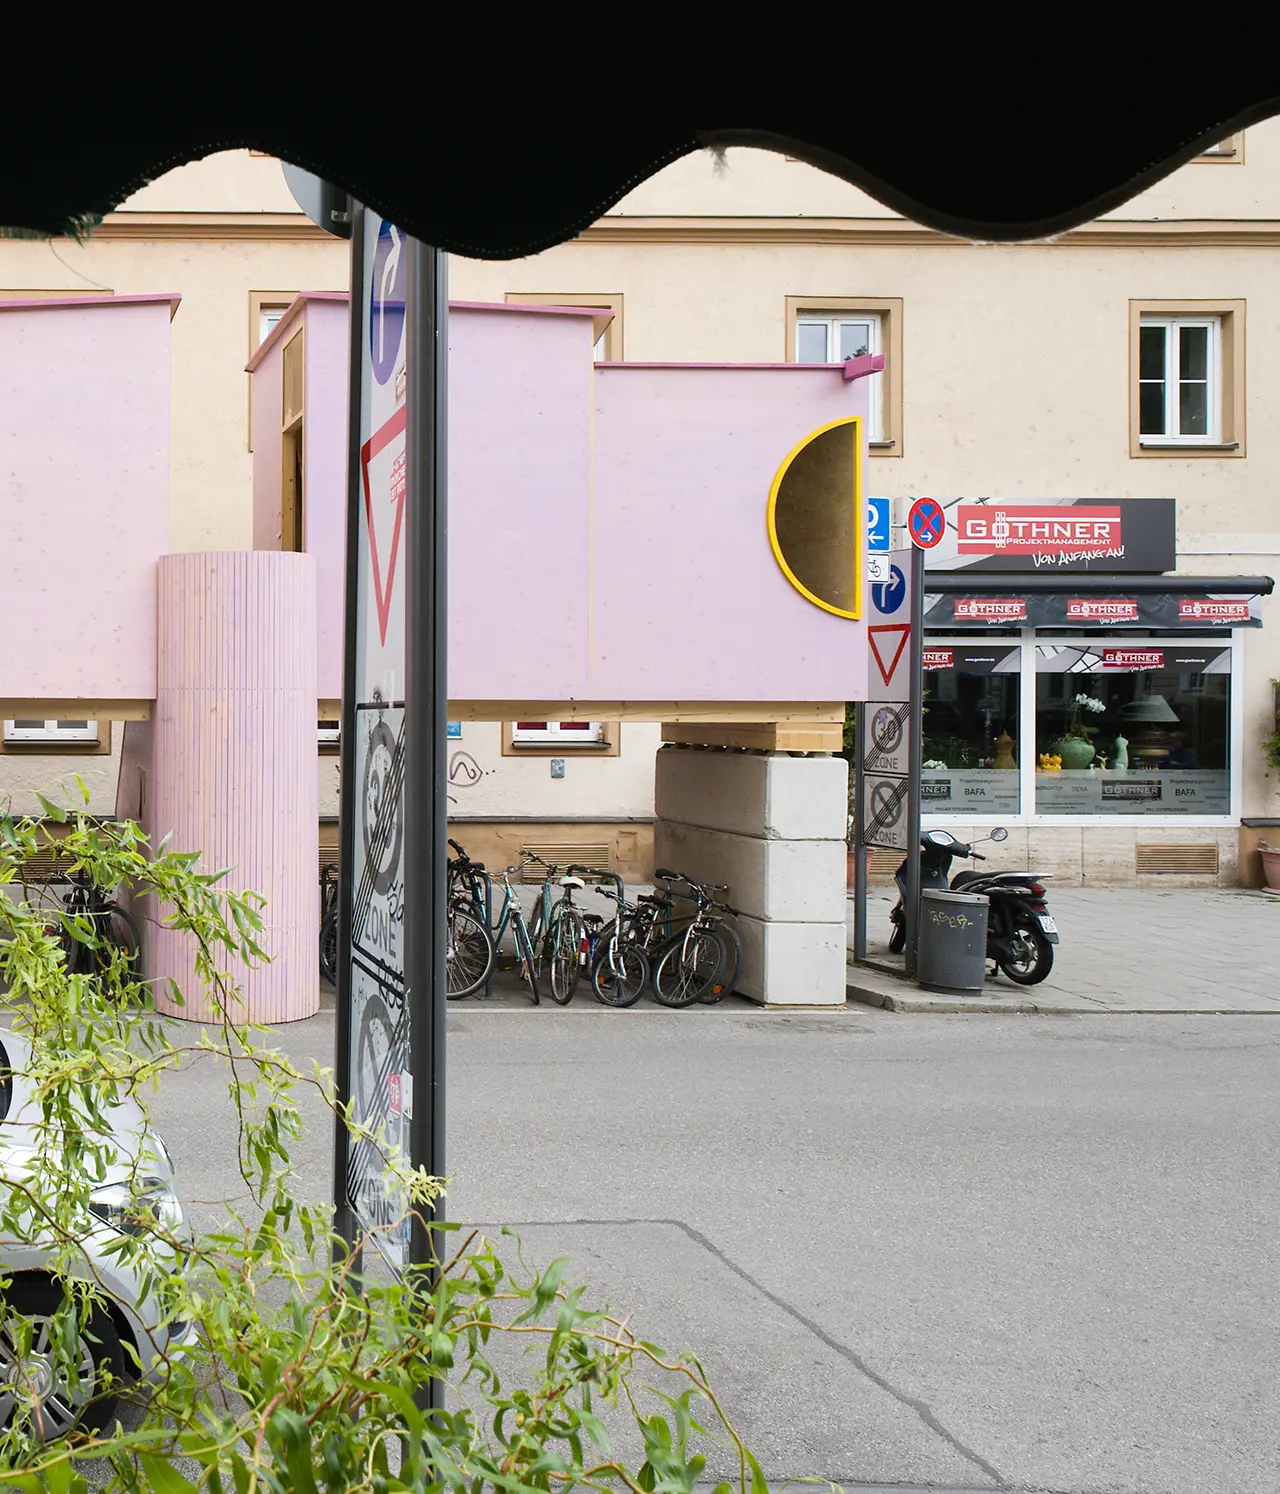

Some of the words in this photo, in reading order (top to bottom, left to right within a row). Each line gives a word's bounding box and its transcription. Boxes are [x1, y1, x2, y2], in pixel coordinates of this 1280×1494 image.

[874, 757, 899, 770] ZONE
[964, 788, 986, 796] BAFA
[874, 832, 898, 845] ZONE
[365, 903, 396, 958] ZONE
